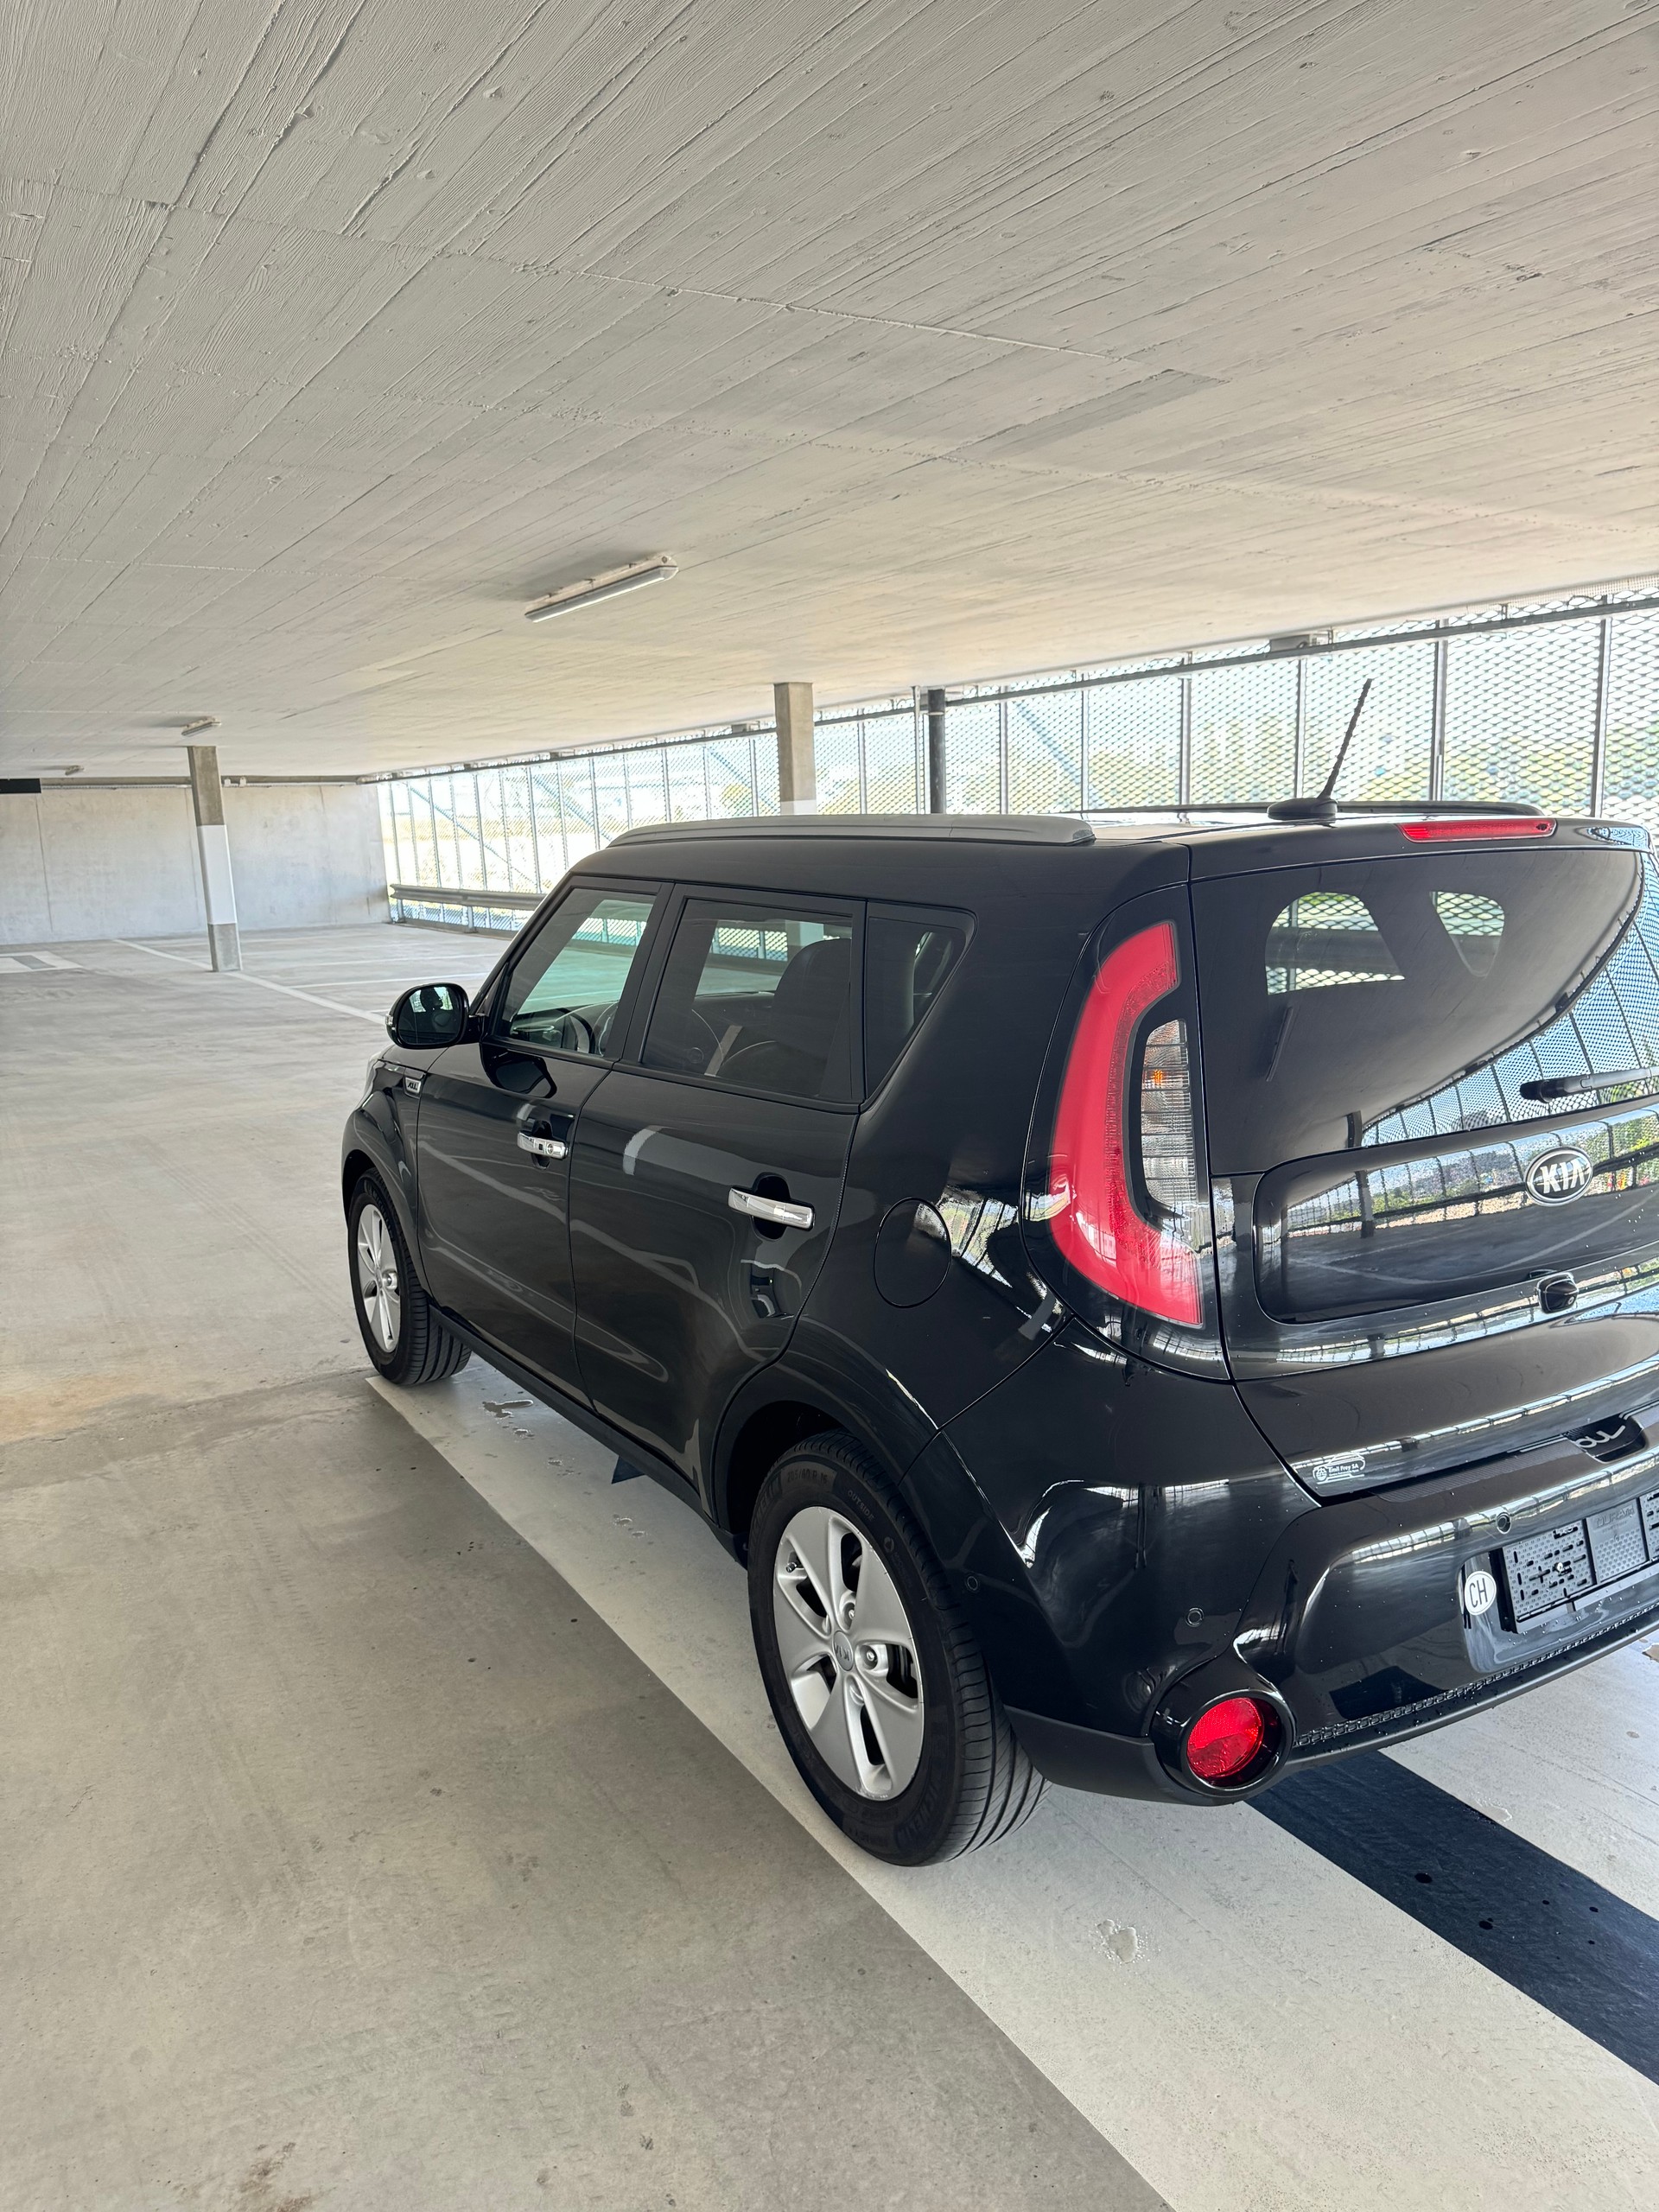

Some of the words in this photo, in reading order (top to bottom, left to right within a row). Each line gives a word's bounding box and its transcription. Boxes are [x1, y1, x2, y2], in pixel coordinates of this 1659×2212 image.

[1540, 1159, 1587, 1193] KIA
[848, 1490, 874, 1521] OUTSIDE
[1469, 1578, 1488, 1608] CH
